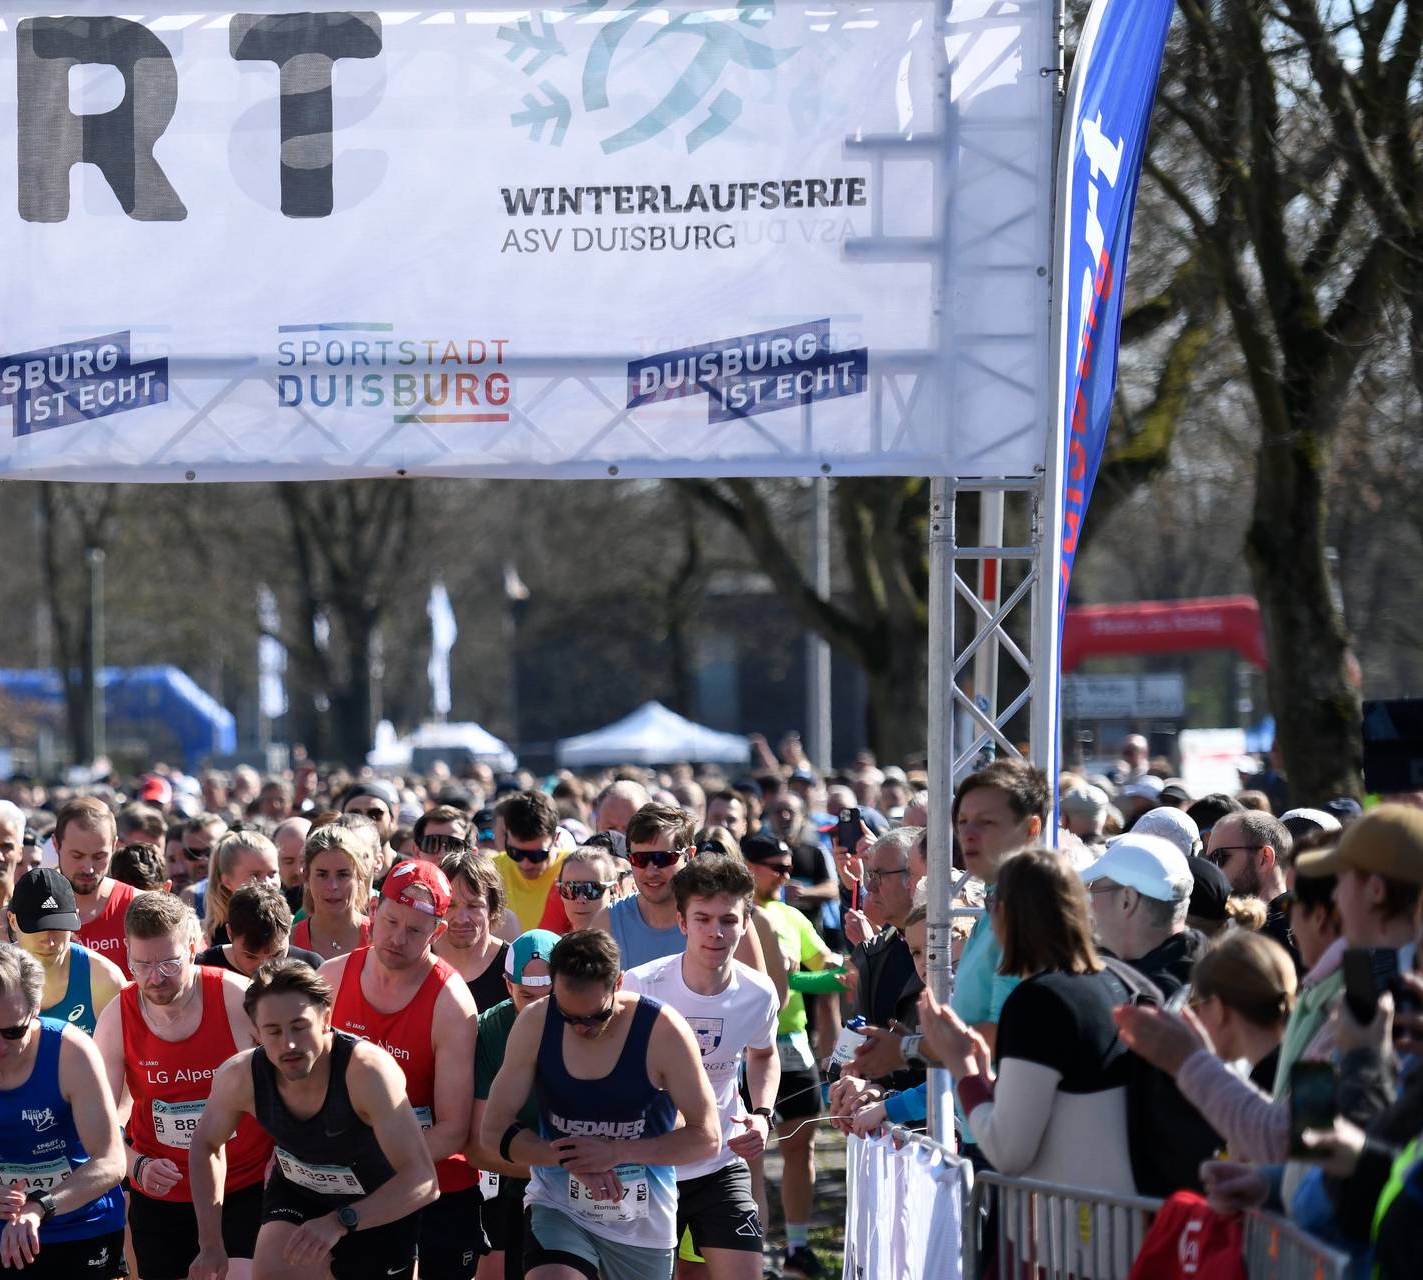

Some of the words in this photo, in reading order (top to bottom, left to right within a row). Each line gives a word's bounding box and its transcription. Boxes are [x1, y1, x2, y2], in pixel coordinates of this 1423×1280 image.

[501, 177, 867, 216] WINTERLAUFSERIE
[501, 228, 562, 253] ASV
[572, 225, 735, 251] DUISBURG
[278, 339, 509, 366] SPORTSTADT
[639, 332, 817, 395] DUISBURG
[25, 391, 70, 424] IST
[79, 370, 156, 411] ECHT
[278, 372, 510, 408] DUISBURG
[721, 378, 767, 412] IST
[777, 360, 856, 400] ECHT
[147, 1070, 169, 1084] LG
[174, 1118, 201, 1131] 88
